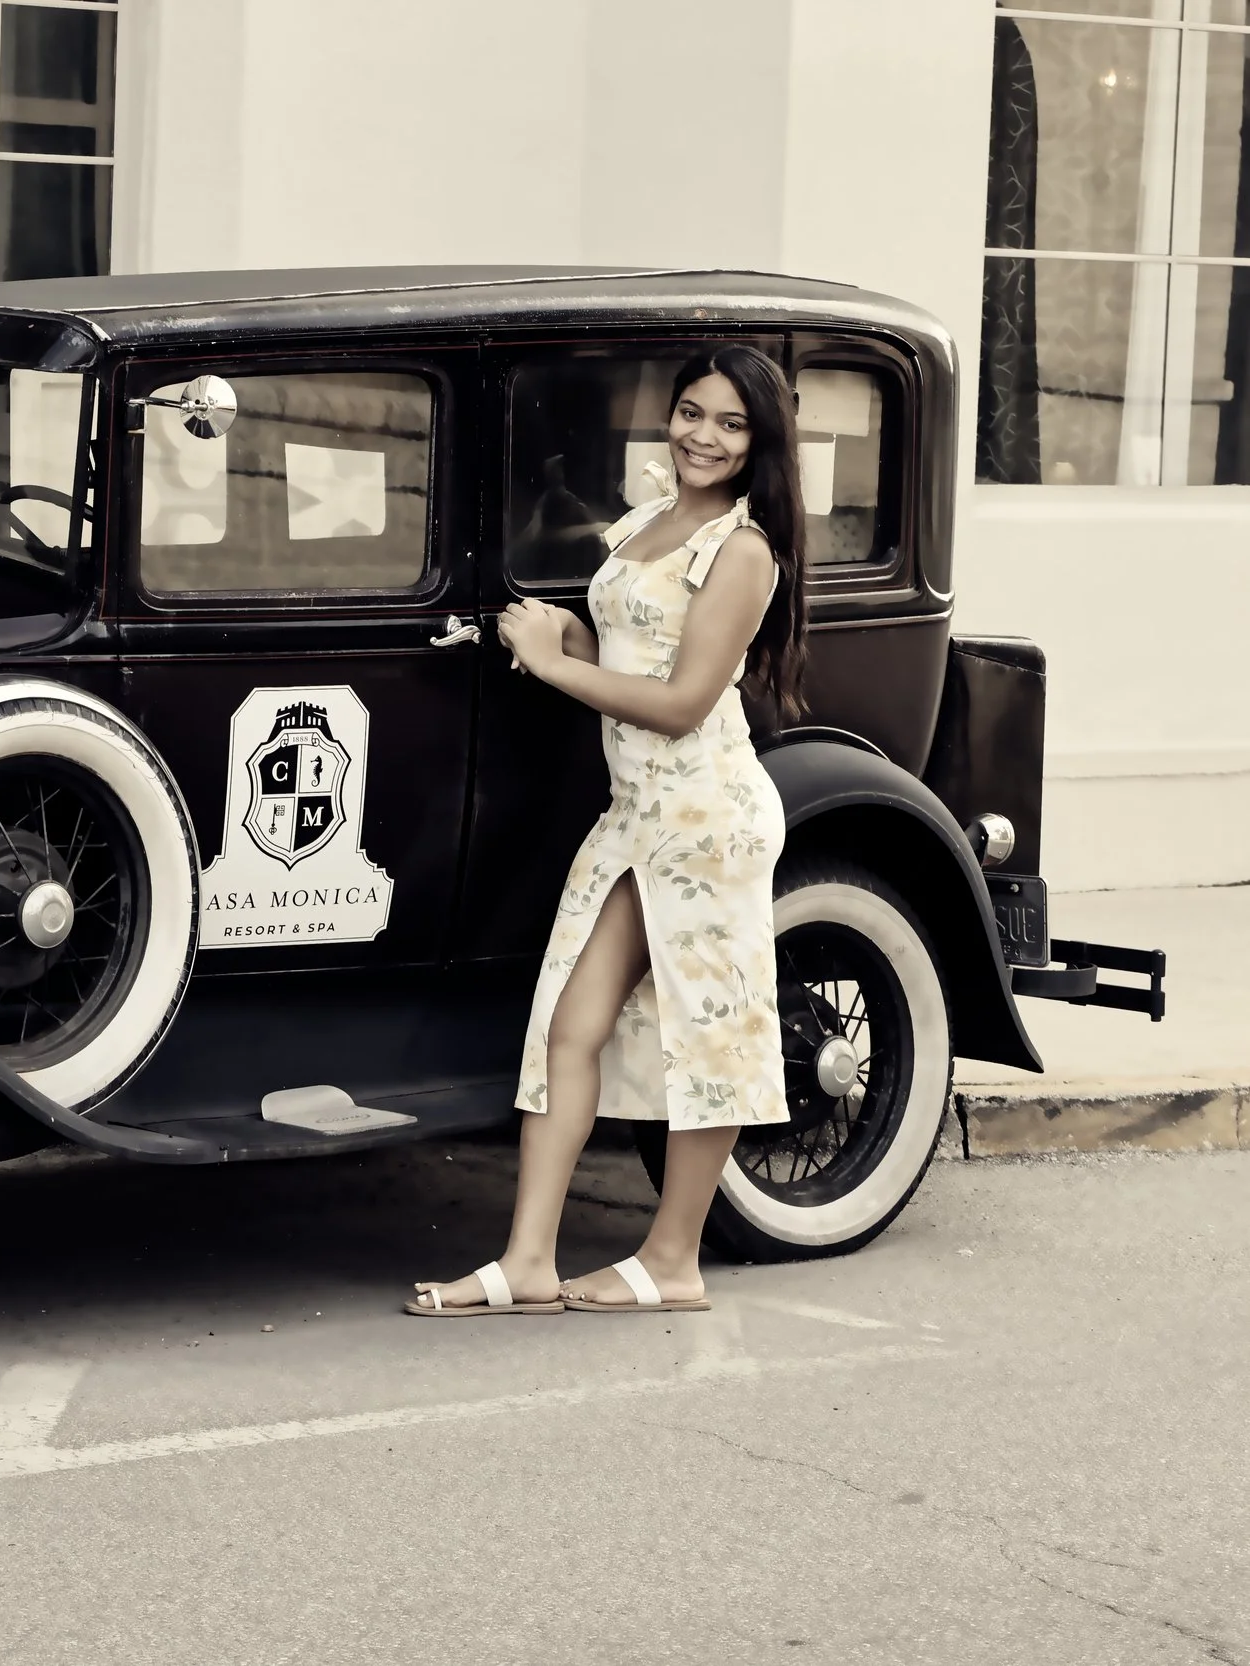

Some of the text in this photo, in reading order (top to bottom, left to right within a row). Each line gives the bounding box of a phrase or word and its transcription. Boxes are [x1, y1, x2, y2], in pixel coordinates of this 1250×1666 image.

[271, 760, 289, 782] C
[301, 806, 325, 827] M
[205, 886, 378, 911] ASA MONICA
[223, 922, 336, 937] RESORT & SPA
